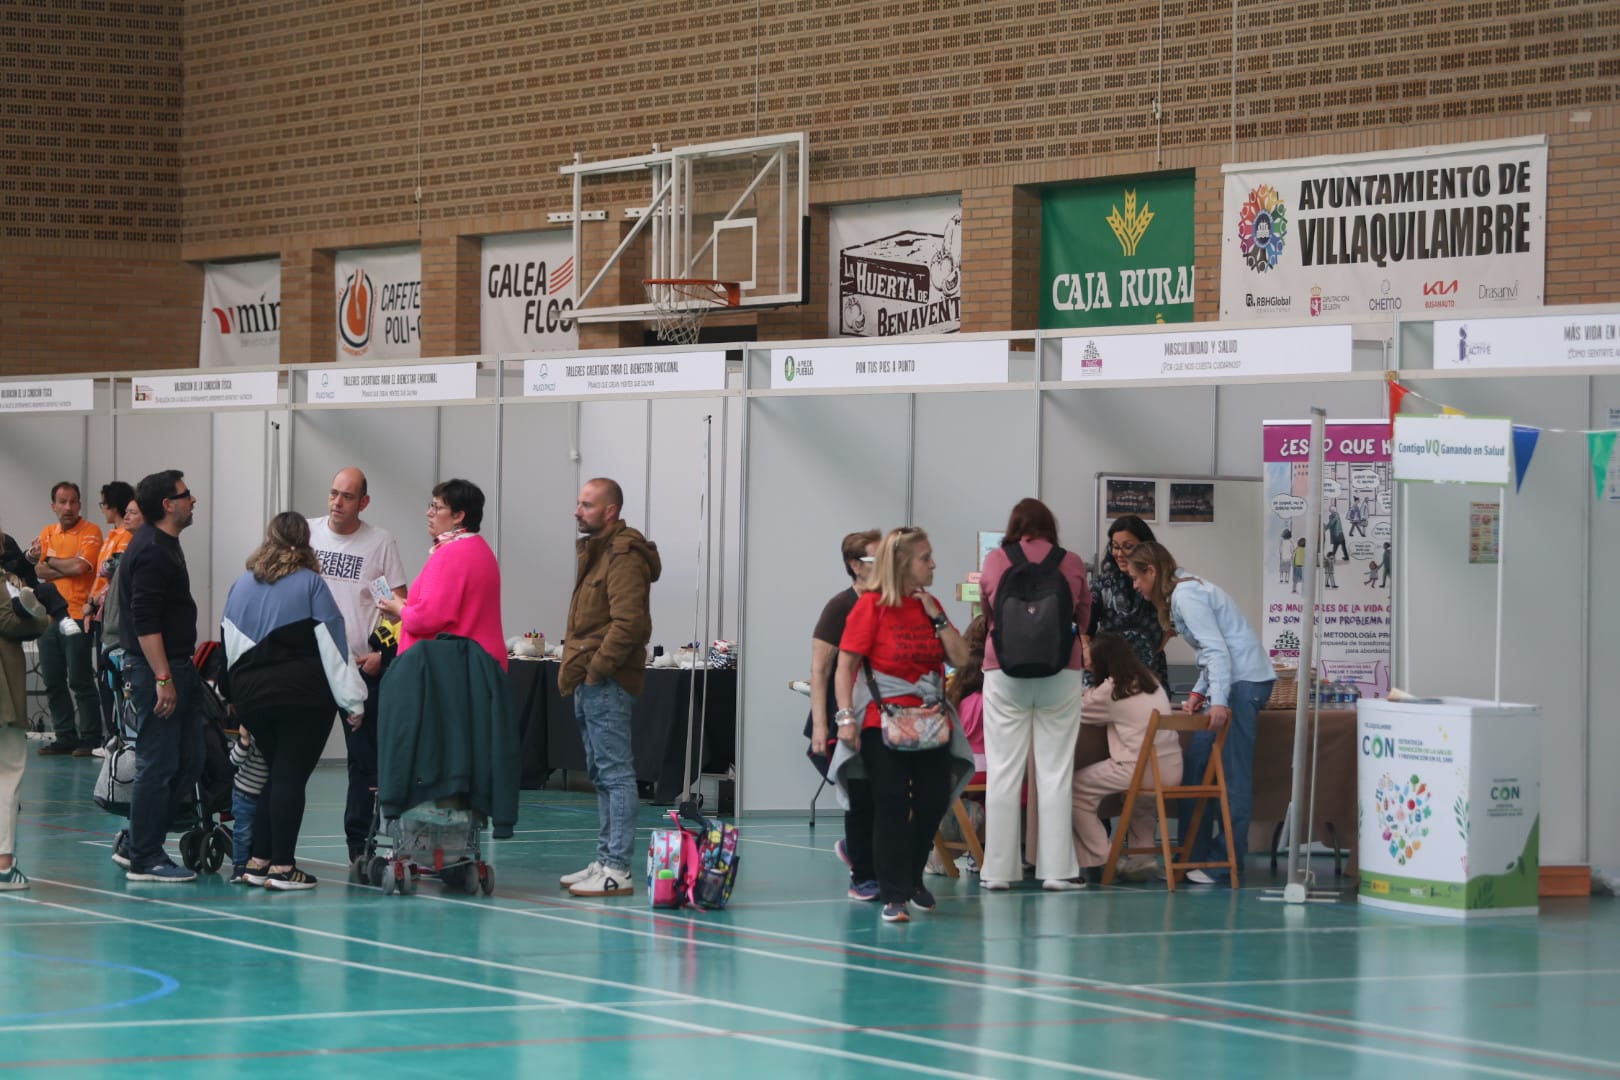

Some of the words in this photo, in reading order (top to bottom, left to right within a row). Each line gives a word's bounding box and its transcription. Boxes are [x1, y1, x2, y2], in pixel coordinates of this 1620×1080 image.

[1299, 164, 1491, 210] AYUNTAMIENTO
[1498, 160, 1530, 195] DE
[1298, 202, 1530, 268] VILLAQUILAMBRE
[488, 261, 546, 298] GALEA
[844, 257, 855, 278] LA
[856, 262, 915, 300] HUERTA
[917, 290, 928, 302] DE
[1052, 271, 1112, 312] CAJA
[1564, 324, 1581, 341] MÁS
[1584, 326, 1602, 340] VIDA
[1164, 340, 1208, 356] MASCULINIDAD
[1211, 341, 1216, 354] Y
[1218, 340, 1238, 354] SALUD
[856, 361, 866, 374] PON
[868, 360, 877, 373] TUS
[880, 360, 890, 373] PIES
[892, 360, 896, 372] A
[898, 360, 916, 372] PUNTO
[1340, 438, 1376, 454] QUE
[1398, 442, 1424, 456] Contigo
[1425, 439, 1440, 456] VQ
[1441, 443, 1472, 455] Ganando
[1474, 447, 1482, 455] en
[1484, 446, 1505, 456] Salud
[1270, 604, 1282, 612] LOS
[1338, 604, 1348, 612] DE
[1352, 604, 1360, 613] LA
[1364, 604, 1382, 612] VIDA
[1269, 616, 1280, 624] NO
[1284, 616, 1300, 624] SON
[1325, 616, 1336, 625] UN
[1340, 616, 1382, 626] PROBLEMA
[1324, 631, 1376, 639] METODOLOGÍA
[1362, 734, 1394, 759] CON
[1490, 786, 1520, 800] CON
